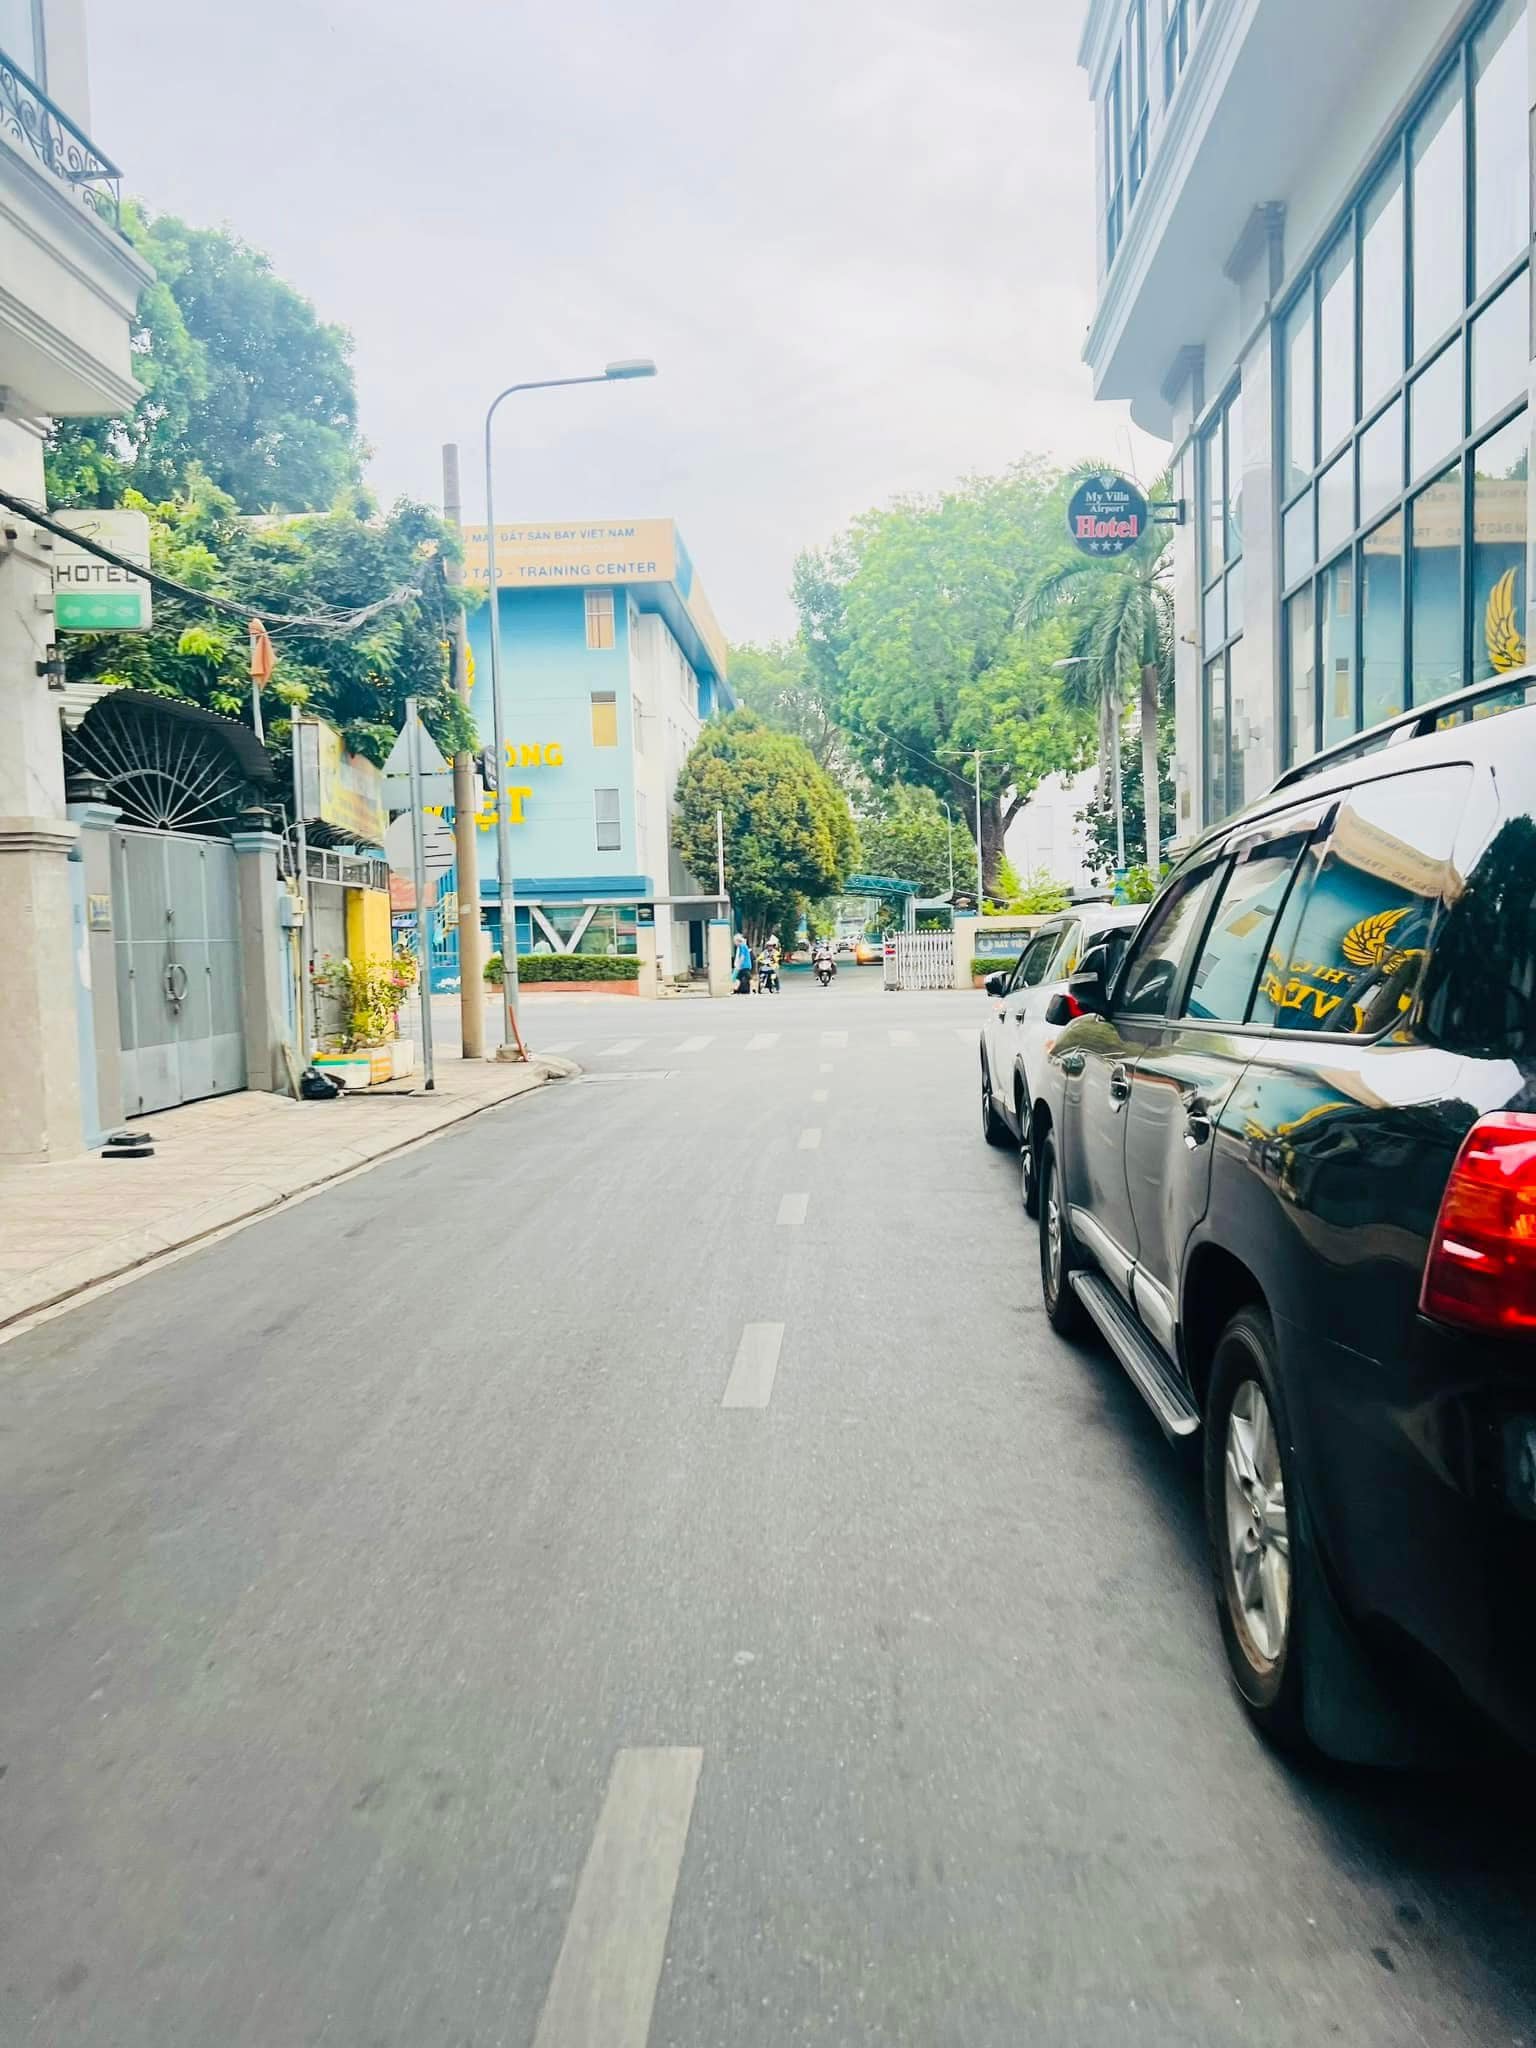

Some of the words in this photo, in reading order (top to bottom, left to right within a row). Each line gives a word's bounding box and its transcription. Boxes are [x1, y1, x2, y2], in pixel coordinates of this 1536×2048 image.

[1085, 491, 1103, 504] My
[1105, 491, 1130, 502] Villa
[1090, 504, 1125, 514] Airport
[608, 527, 635, 537] NAM
[1075, 515, 1139, 538] Hotel
[56, 565, 138, 583] HOTEL
[519, 565, 591, 577] TRAINING
[596, 562, 657, 575] CENTER
